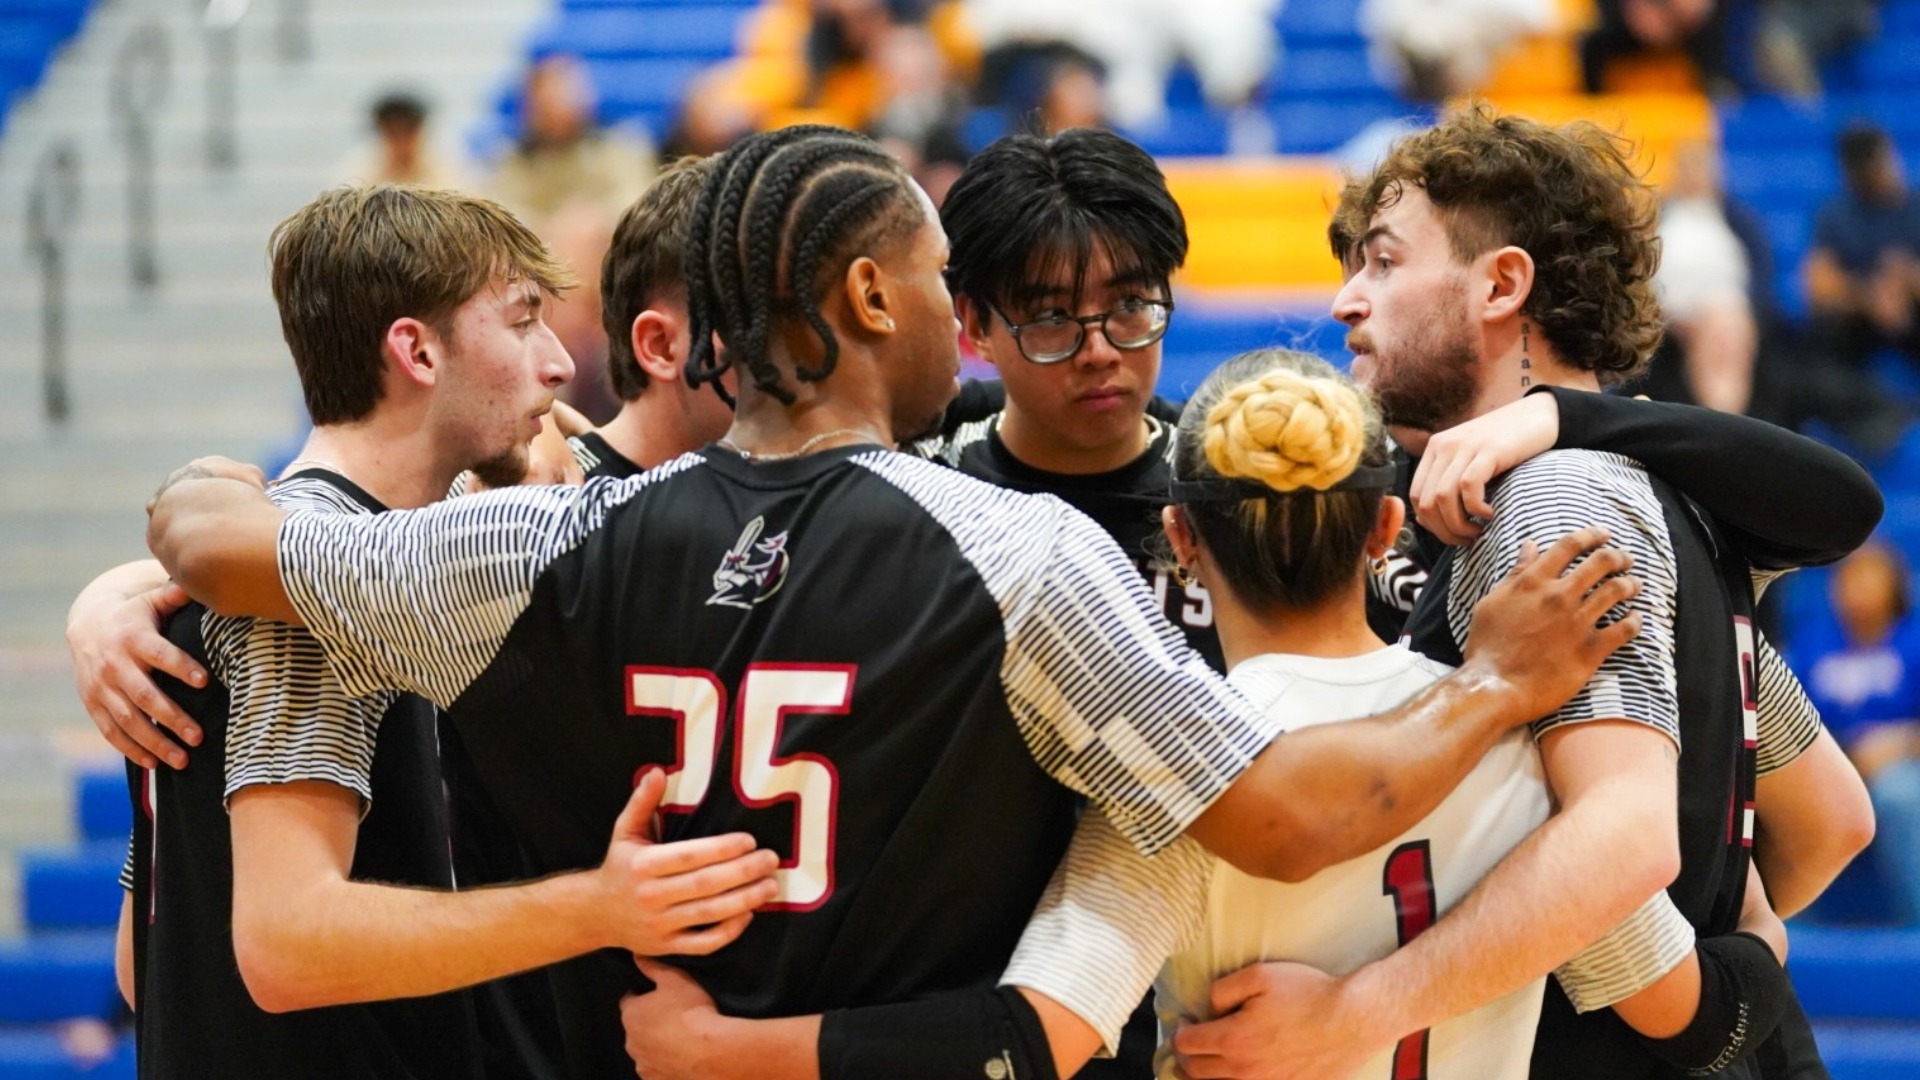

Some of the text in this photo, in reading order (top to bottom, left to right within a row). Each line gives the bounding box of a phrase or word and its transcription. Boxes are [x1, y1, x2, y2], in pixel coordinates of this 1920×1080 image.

[1133, 558, 1213, 628] TS
[624, 662, 858, 912] 25
[1382, 838, 1437, 1080] 1
